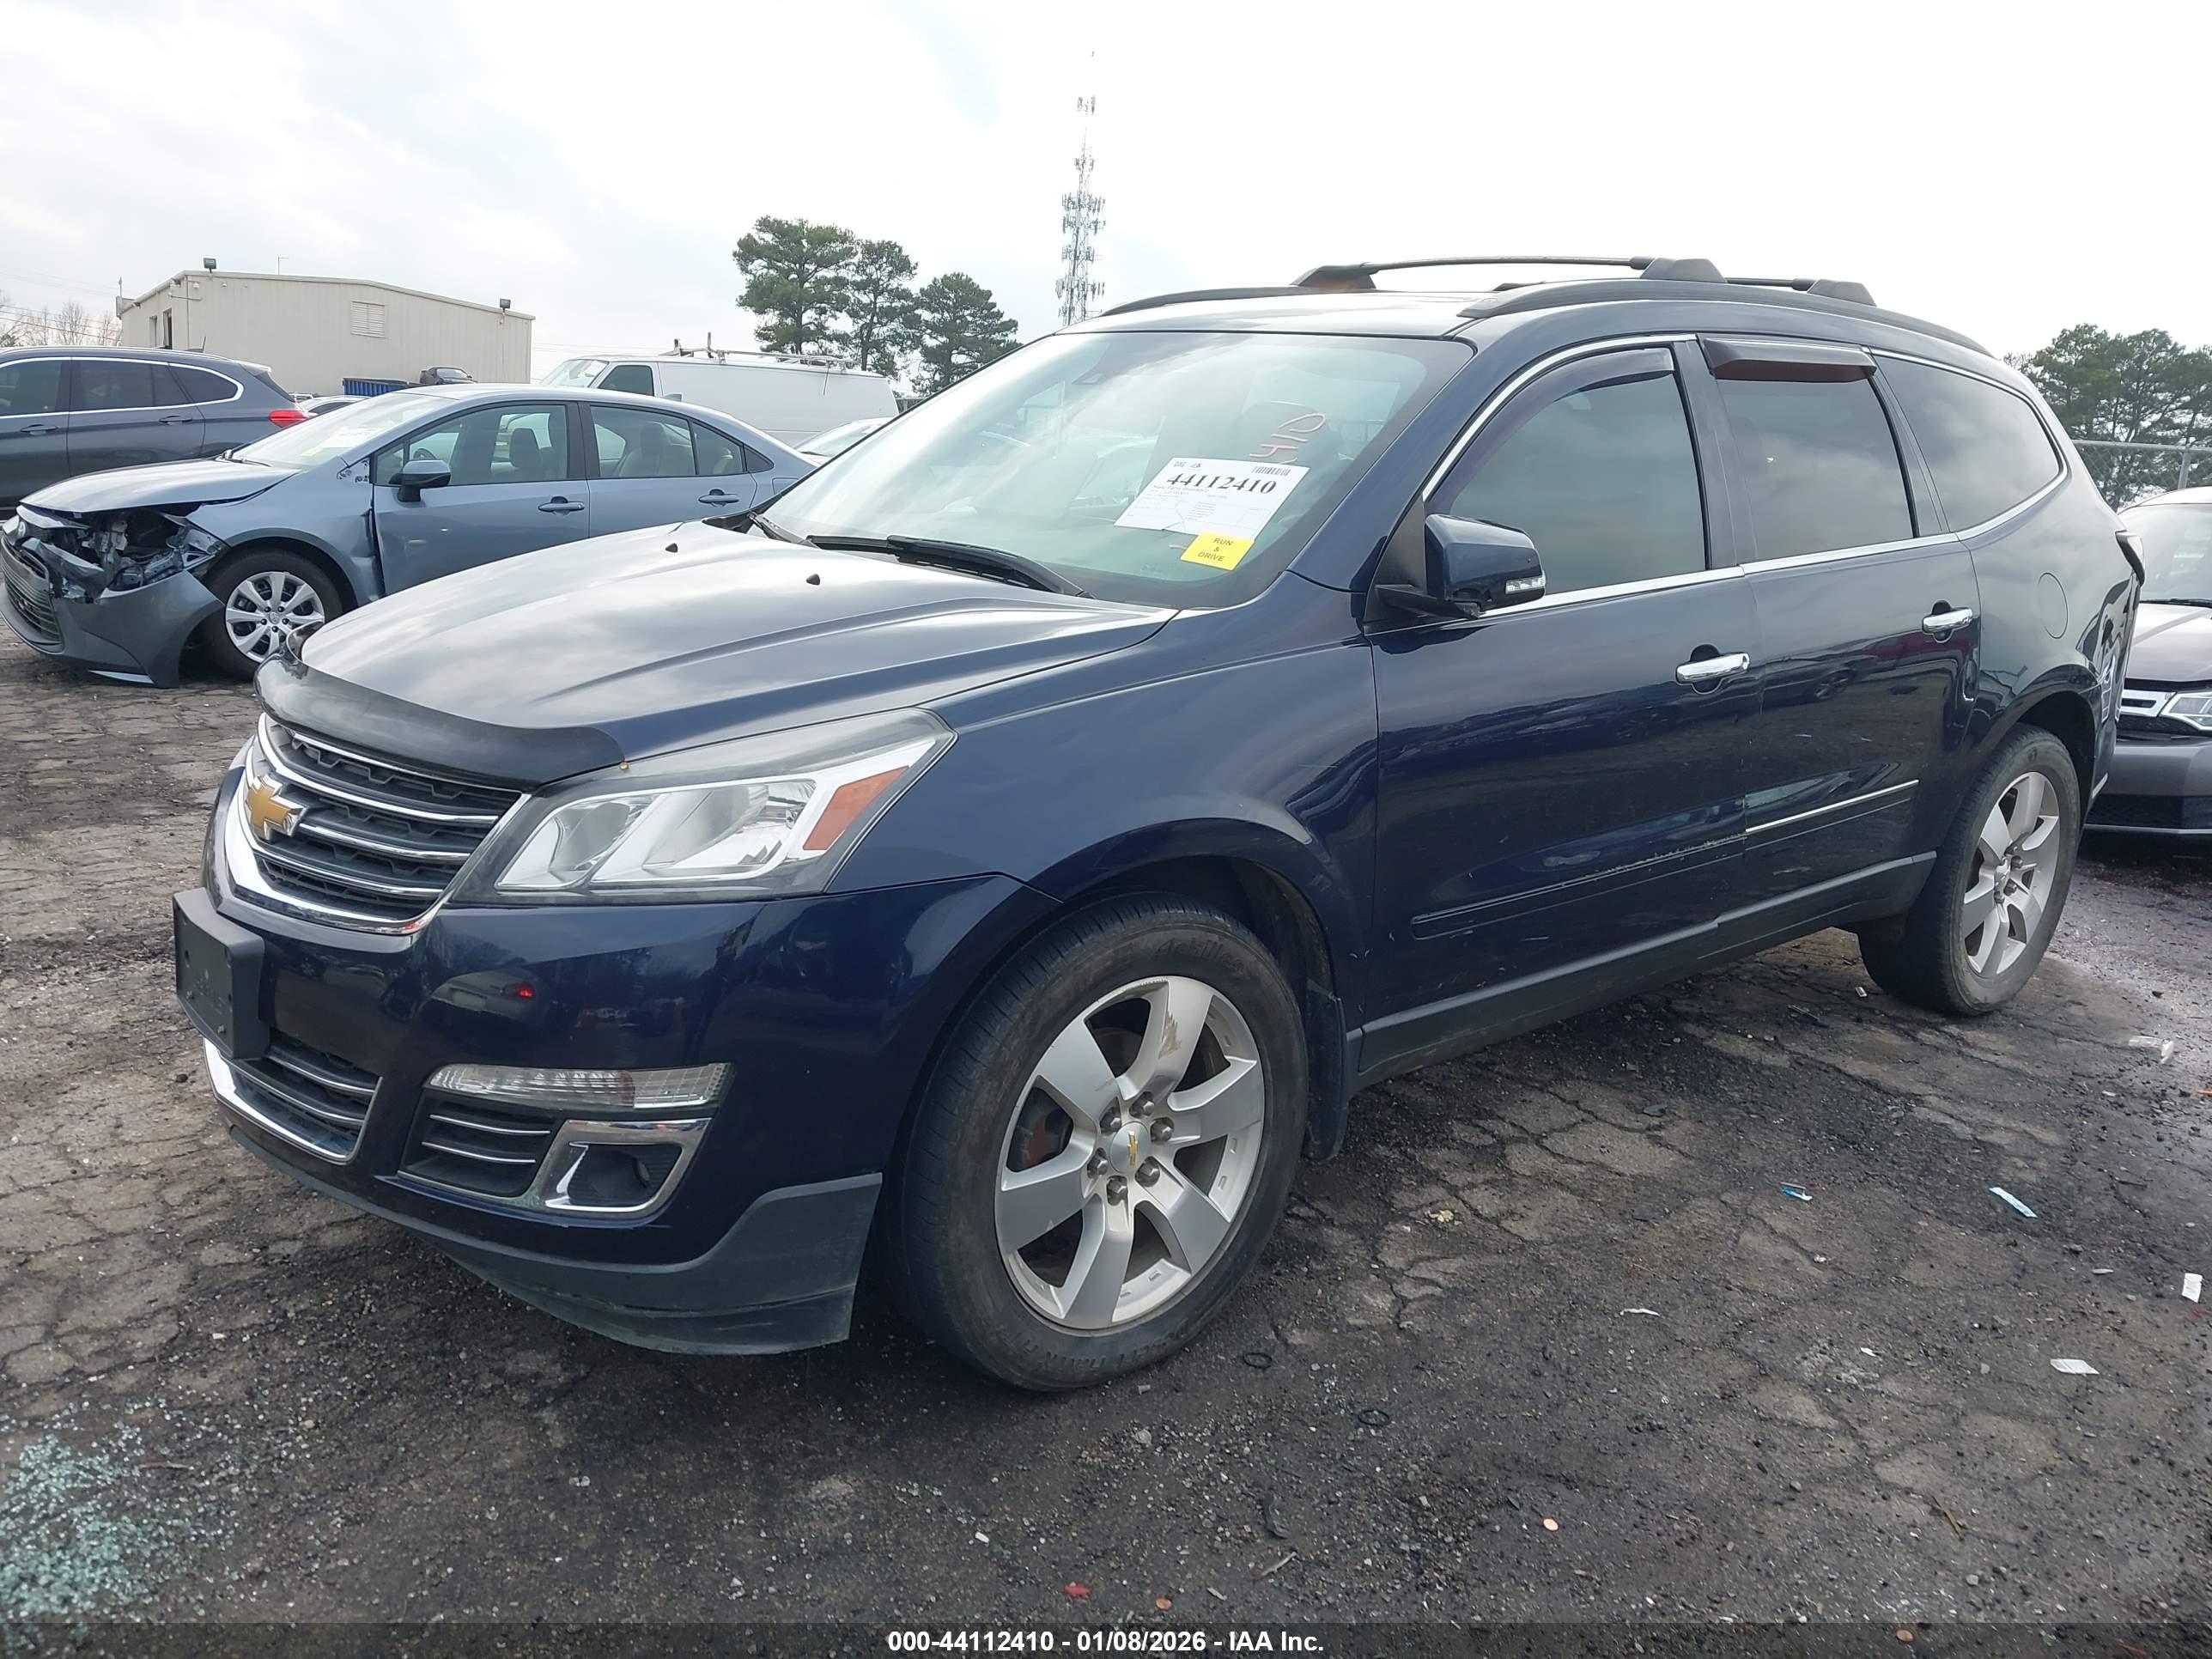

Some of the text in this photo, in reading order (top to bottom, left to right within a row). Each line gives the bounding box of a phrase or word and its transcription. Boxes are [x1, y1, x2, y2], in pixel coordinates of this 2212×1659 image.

[1166, 473, 1277, 495] 44112410
[1212, 538, 1234, 546] RUN
[1197, 551, 1225, 562] DRIVE
